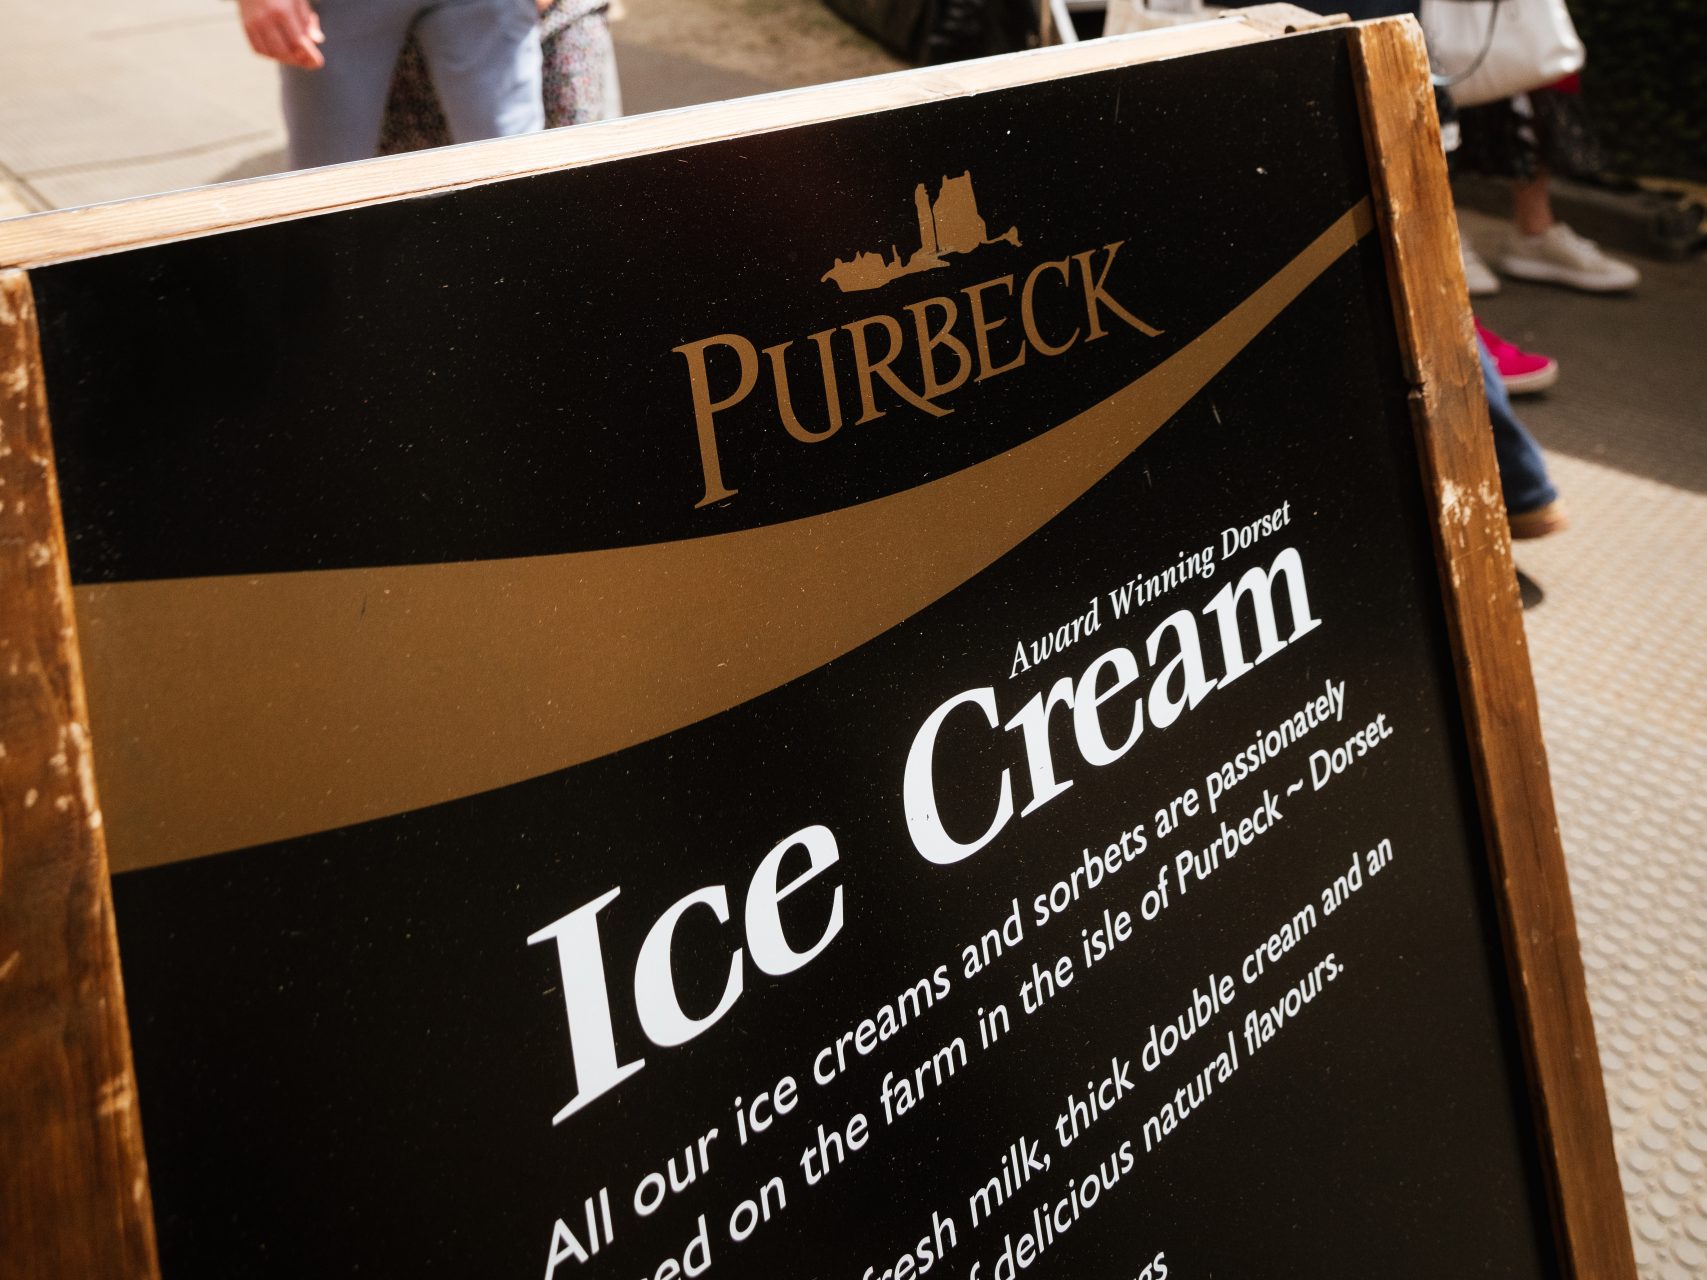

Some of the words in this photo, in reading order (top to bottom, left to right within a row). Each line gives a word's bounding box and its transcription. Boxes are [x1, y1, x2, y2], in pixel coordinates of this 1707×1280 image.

[672, 240, 1165, 509] PURBECK
[1006, 596, 1102, 680] Award
[1107, 545, 1216, 620] Winning
[1219, 499, 1292, 561] Dorset
[526, 824, 844, 1126] Ice
[902, 547, 1323, 865] Cream
[544, 1186, 614, 1280] All
[633, 1127, 719, 1217] our
[734, 1075, 799, 1146] ice
[813, 964, 951, 1086] creams
[961, 897, 1024, 979] and
[1033, 824, 1148, 927] sorbets
[1154, 788, 1200, 839] are
[1205, 678, 1345, 814] passionately
[729, 1176, 787, 1242] on
[799, 1113, 870, 1186] the
[879, 1037, 968, 1126] farm
[977, 1004, 1010, 1050] in
[1018, 955, 1074, 1015] the
[1081, 908, 1133, 969] isle
[1140, 864, 1169, 921] of
[1175, 789, 1284, 895] Purbeck
[1308, 713, 1394, 792] Dorset.
[862, 1210, 957, 1280] esh
[969, 1135, 1051, 1229] milk,
[1054, 1056, 1136, 1148] thick
[1141, 973, 1236, 1072] double
[1242, 903, 1317, 984] cream
[1321, 851, 1363, 916] and
[1366, 838, 1393, 877] an
[994, 1140, 1135, 1280] delicious
[1142, 1030, 1239, 1153] natural
[1243, 952, 1344, 1056] flavours.
